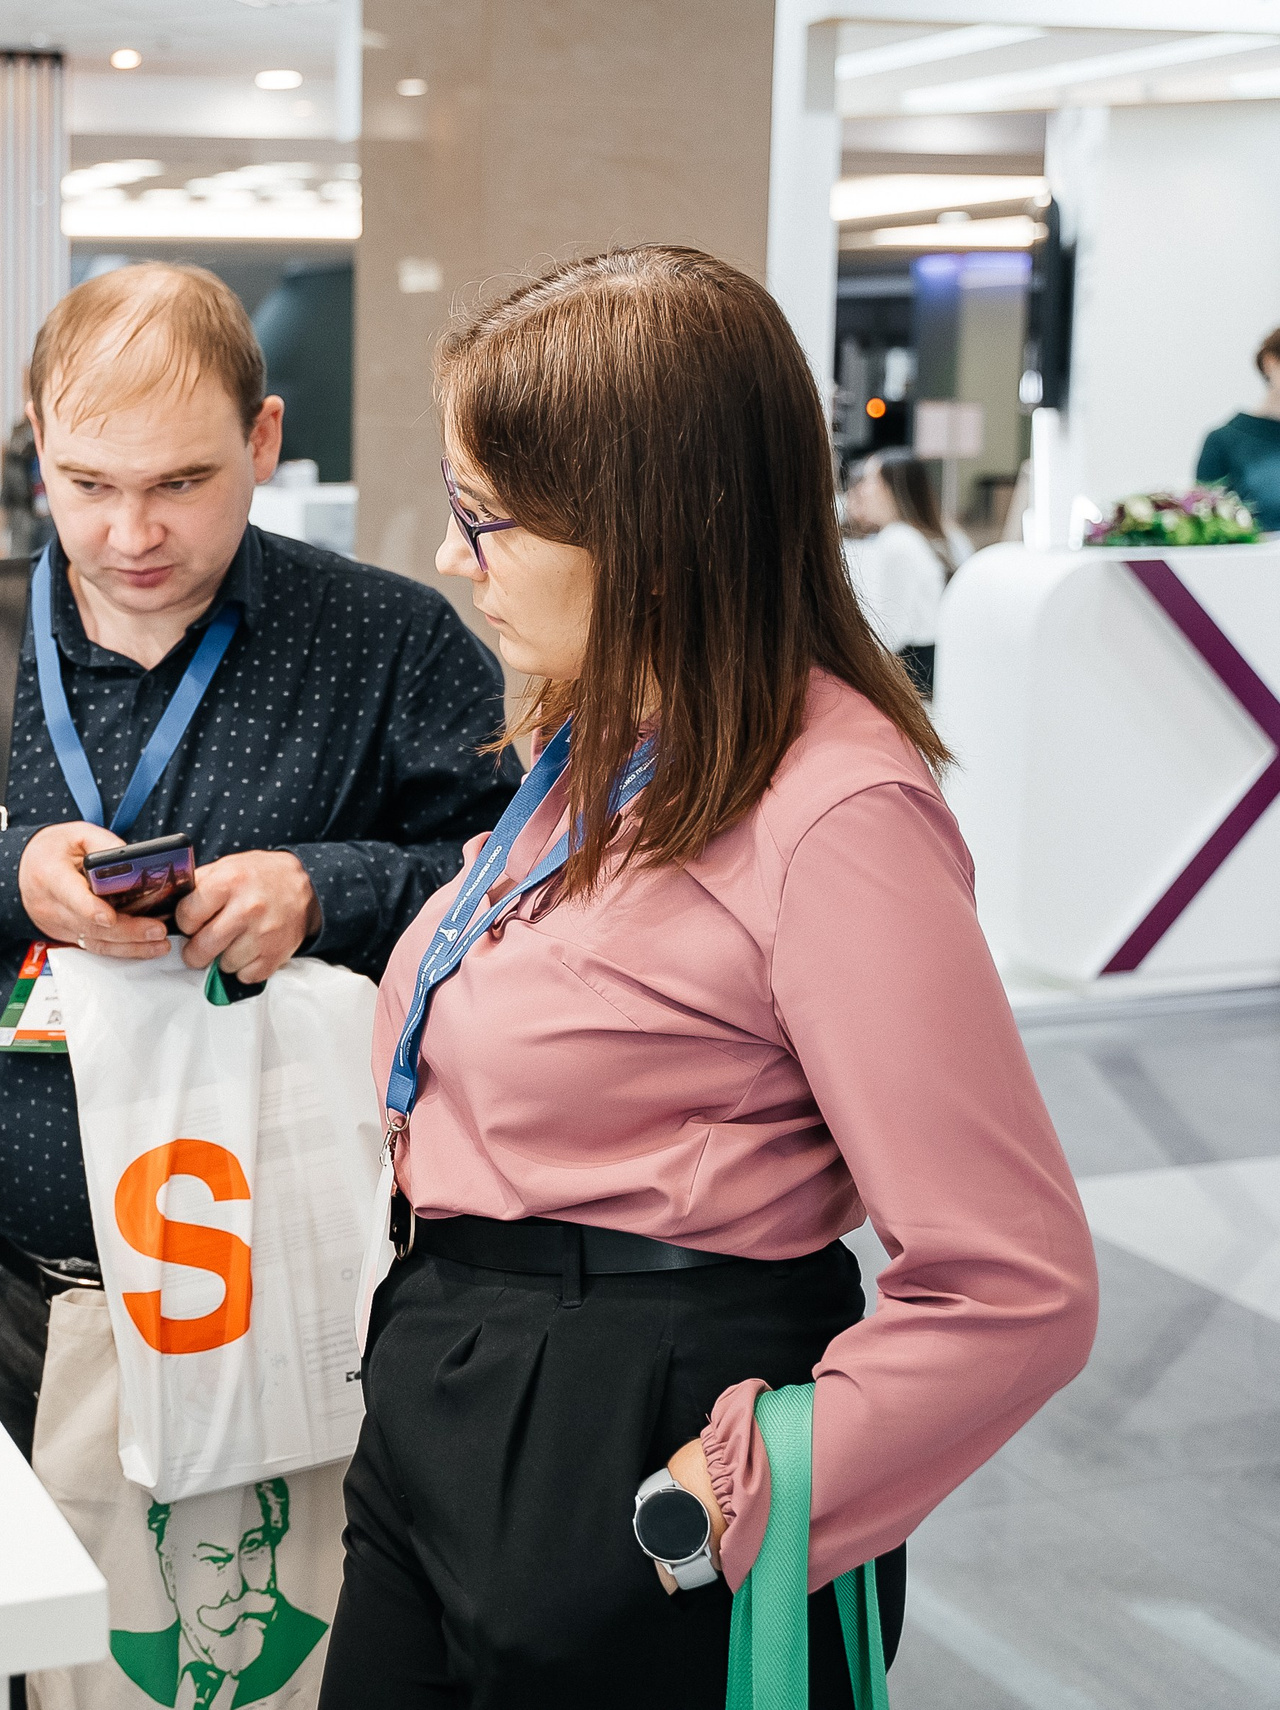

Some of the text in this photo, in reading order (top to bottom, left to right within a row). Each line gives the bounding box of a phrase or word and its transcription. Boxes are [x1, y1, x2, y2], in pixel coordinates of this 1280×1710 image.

[487, 845, 503, 863] СОЮЗ
[465, 862, 491, 897] ПЕДИАТРОВ
[451, 896, 468, 922] РОССИИ
[114, 1138, 252, 1354] S
